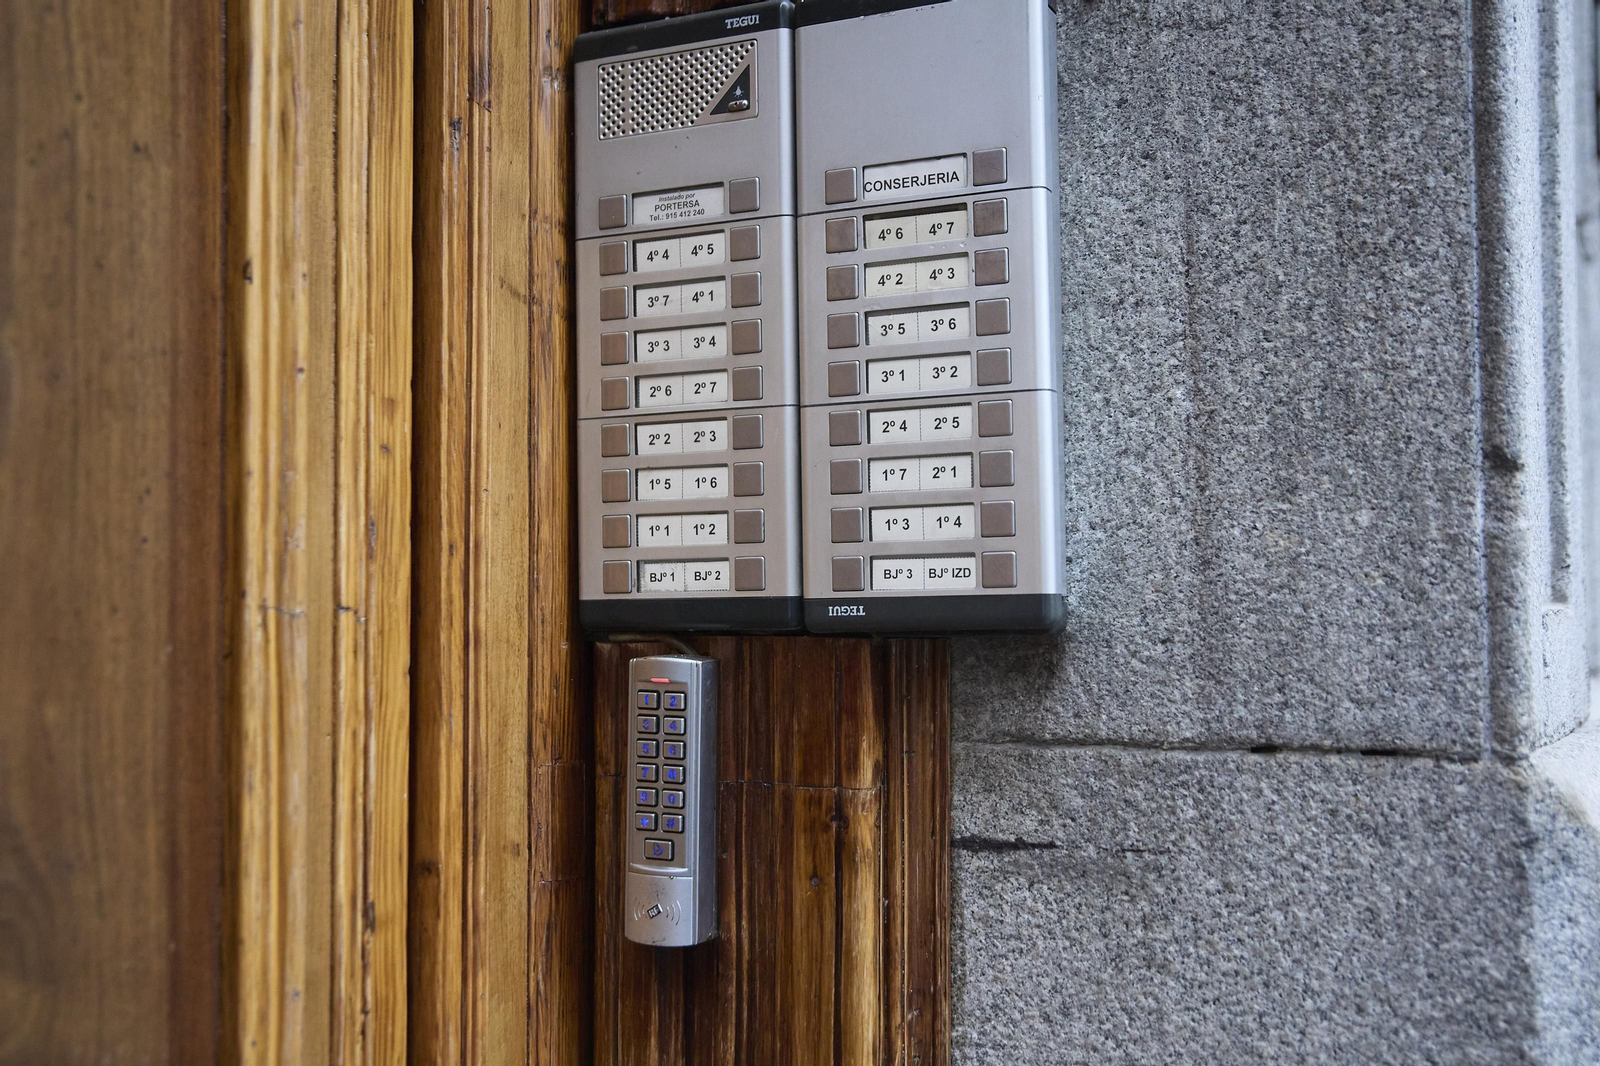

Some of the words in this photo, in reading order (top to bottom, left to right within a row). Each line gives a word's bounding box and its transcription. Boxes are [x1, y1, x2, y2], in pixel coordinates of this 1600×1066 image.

[725, 15, 760, 29] TEGUI
[864, 171, 959, 192] CONSERJERIA
[659, 194, 684, 202] Instalado
[654, 200, 700, 212] PORTERSA
[878, 228, 891, 241] 4º
[896, 228, 903, 239] 6
[929, 222, 942, 236] 4º
[946, 222, 954, 234] 7
[647, 250, 659, 262] 4º
[662, 249, 669, 260] 4
[691, 244, 703, 256] 4º
[707, 243, 714, 254] 5
[878, 274, 891, 286] 4º
[896, 273, 903, 284] 2
[930, 268, 943, 281] 4º
[947, 267, 955, 279] 3
[648, 296, 659, 308] 3º
[662, 295, 669, 306] 7
[692, 291, 704, 303] 4º
[708, 290, 714, 301] 1
[880, 323, 893, 336] 3º
[898, 323, 906, 334] 5
[931, 319, 944, 331] 3º
[949, 318, 956, 330] 6
[648, 341, 659, 352] 3º
[663, 340, 670, 351] 3
[693, 336, 705, 349] 3º
[708, 336, 716, 347] 4
[881, 370, 894, 382] 3º
[899, 369, 905, 381] 1
[932, 366, 946, 379] 3º
[950, 366, 958, 378] 2
[650, 386, 661, 398] 2º
[665, 385, 672, 396] 6
[694, 382, 706, 394] 2º
[710, 382, 717, 393] 7
[882, 421, 895, 433] 2º
[899, 420, 907, 431] 4
[934, 417, 947, 430] 2º
[952, 417, 960, 428] 5
[649, 434, 660, 445] 2º
[664, 433, 671, 444] 2
[694, 431, 705, 442] 2º
[709, 430, 716, 441] 3
[882, 469, 895, 481] 1º
[899, 468, 907, 480] 7
[932, 466, 946, 479] 2º
[950, 466, 957, 478] 1
[649, 479, 660, 490] 1º
[664, 479, 671, 489] 5
[694, 477, 706, 489] 1º
[710, 477, 717, 488] 6
[885, 519, 898, 531] 1º
[902, 518, 910, 530] 3
[936, 516, 949, 528] 1º
[954, 516, 962, 528] 4
[649, 525, 660, 536] 1º
[664, 525, 670, 536] 1
[693, 524, 705, 535] 1º
[709, 524, 716, 535] 2
[650, 572, 667, 582] BJº
[670, 572, 675, 582] 1
[694, 571, 712, 581] BJº
[715, 571, 721, 580] 2
[883, 569, 903, 579] BJº
[906, 568, 913, 579] 3
[928, 568, 948, 578] BJº
[952, 568, 971, 578] IZD
[828, 606, 865, 616] TEGUI
